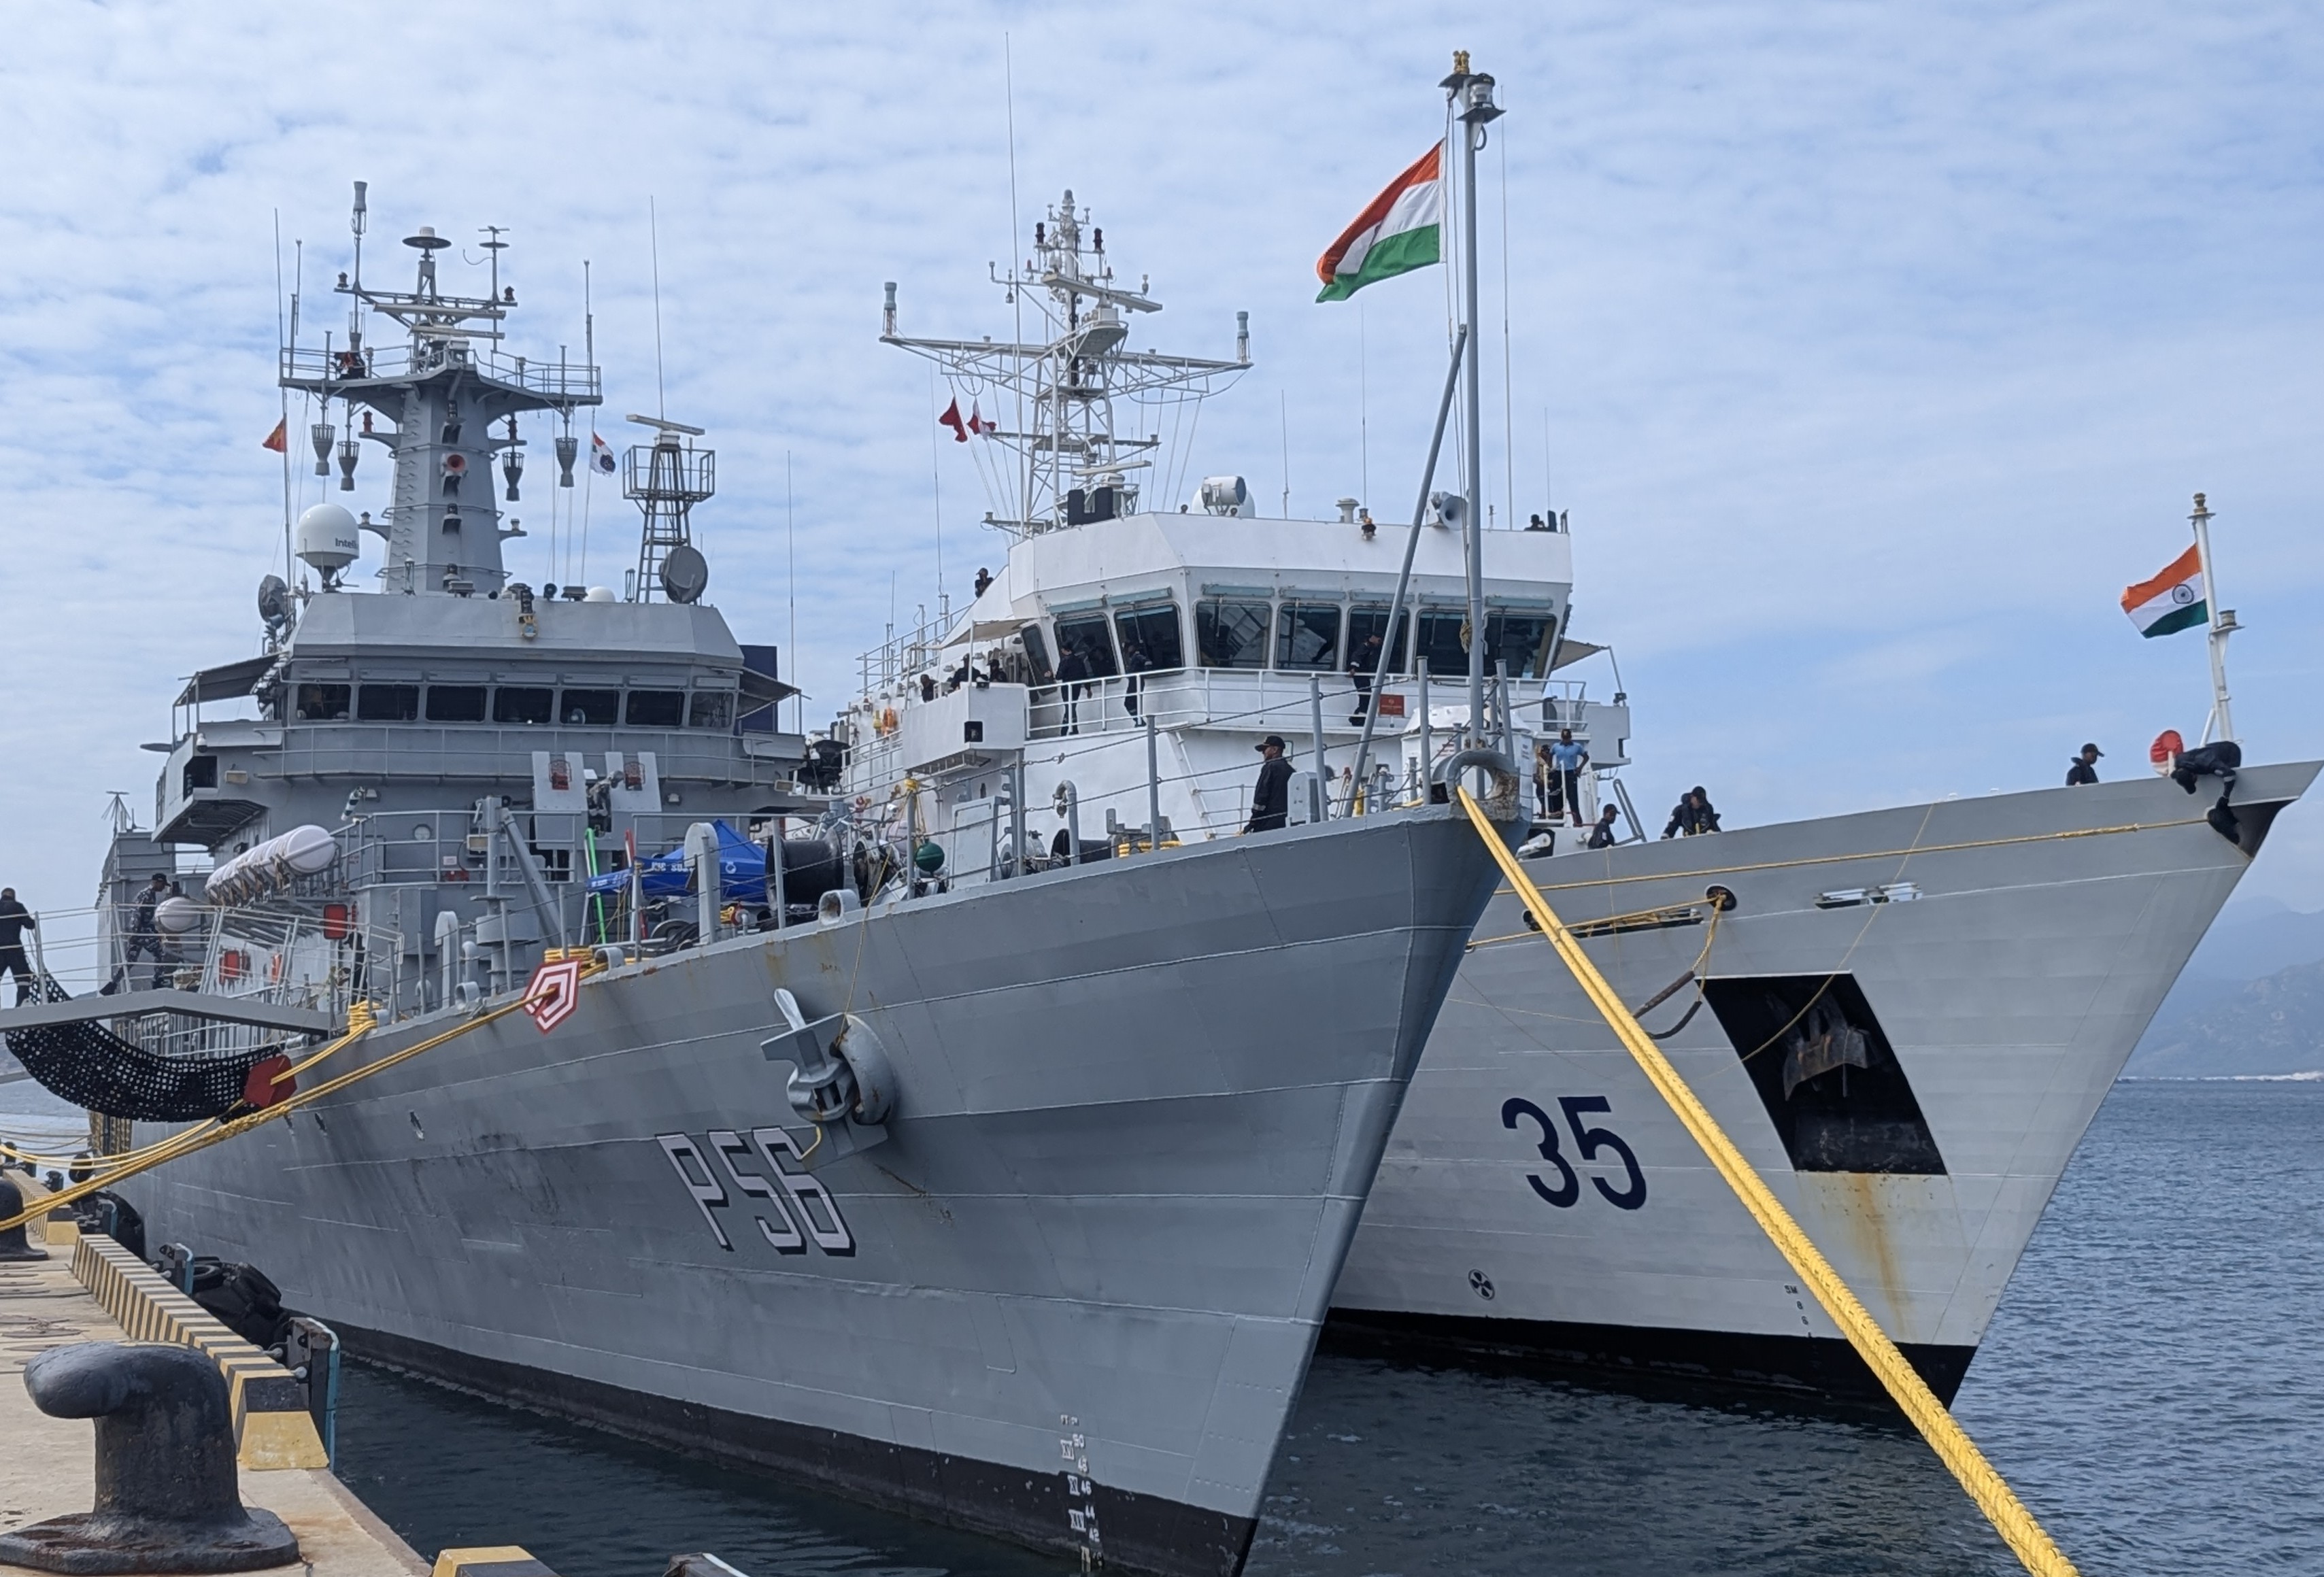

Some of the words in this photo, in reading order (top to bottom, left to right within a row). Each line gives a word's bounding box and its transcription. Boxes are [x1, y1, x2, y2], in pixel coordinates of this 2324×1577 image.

[1502, 1096, 1646, 1210] 35
[656, 1126, 856, 1257] P56
[1073, 1434, 1085, 1448] 50
[1060, 1440, 1075, 1461] XVI
[1078, 1457, 1089, 1474] 48
[1081, 1480, 1092, 1495] 46
[1068, 1509, 1086, 1533] XIV
[1085, 1505, 1095, 1520] 44
[1089, 1527, 1100, 1542] 42
